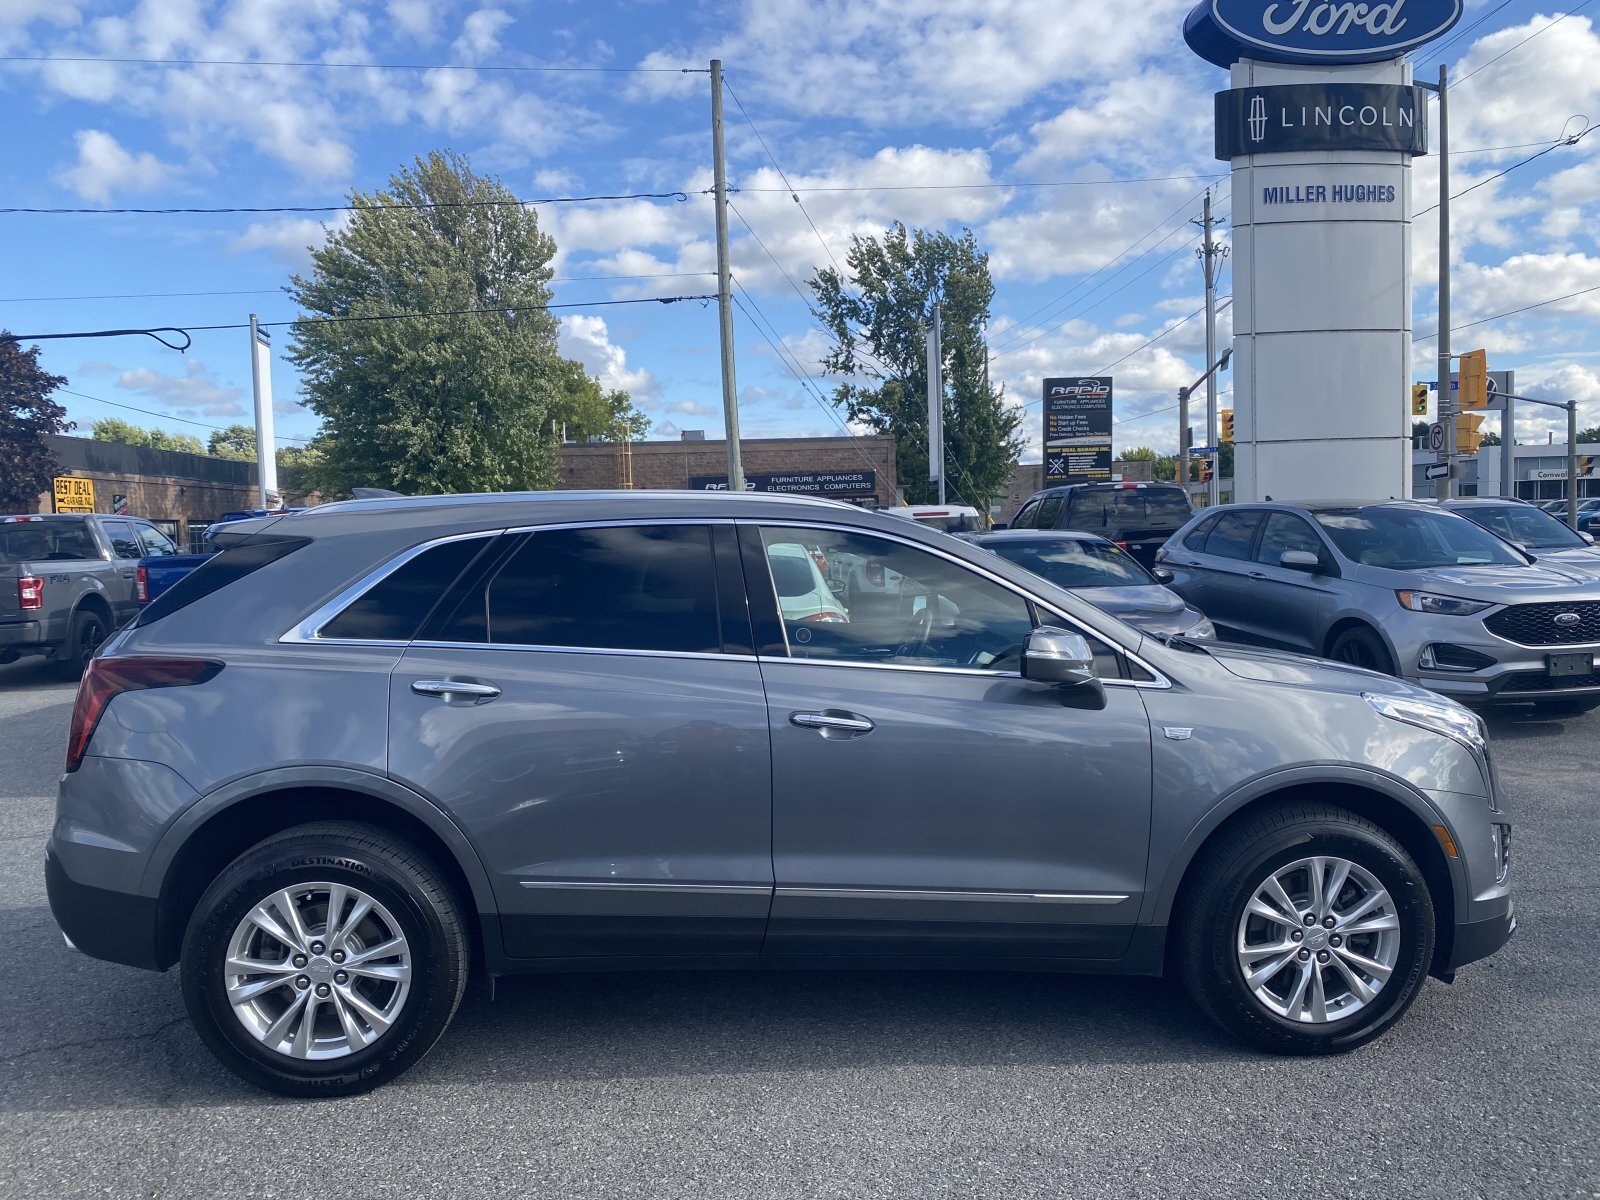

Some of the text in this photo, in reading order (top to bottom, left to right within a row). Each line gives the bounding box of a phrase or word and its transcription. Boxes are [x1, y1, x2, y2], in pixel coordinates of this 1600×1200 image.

[1262, 0, 1407, 36] Ford
[1281, 105, 1413, 128] LINCOLN
[1263, 184, 1396, 205] MILLER HUGHES
[1051, 386, 1110, 394] RAPID
[771, 474, 864, 484] FURNITURE APPLIANCES
[1538, 470, 1568, 478] Cornwal
[56, 479, 91, 496] BEST DEAL
[767, 482, 871, 492] ELECTRONICS COMPUTERS
[292, 857, 372, 876] DESTINATION
